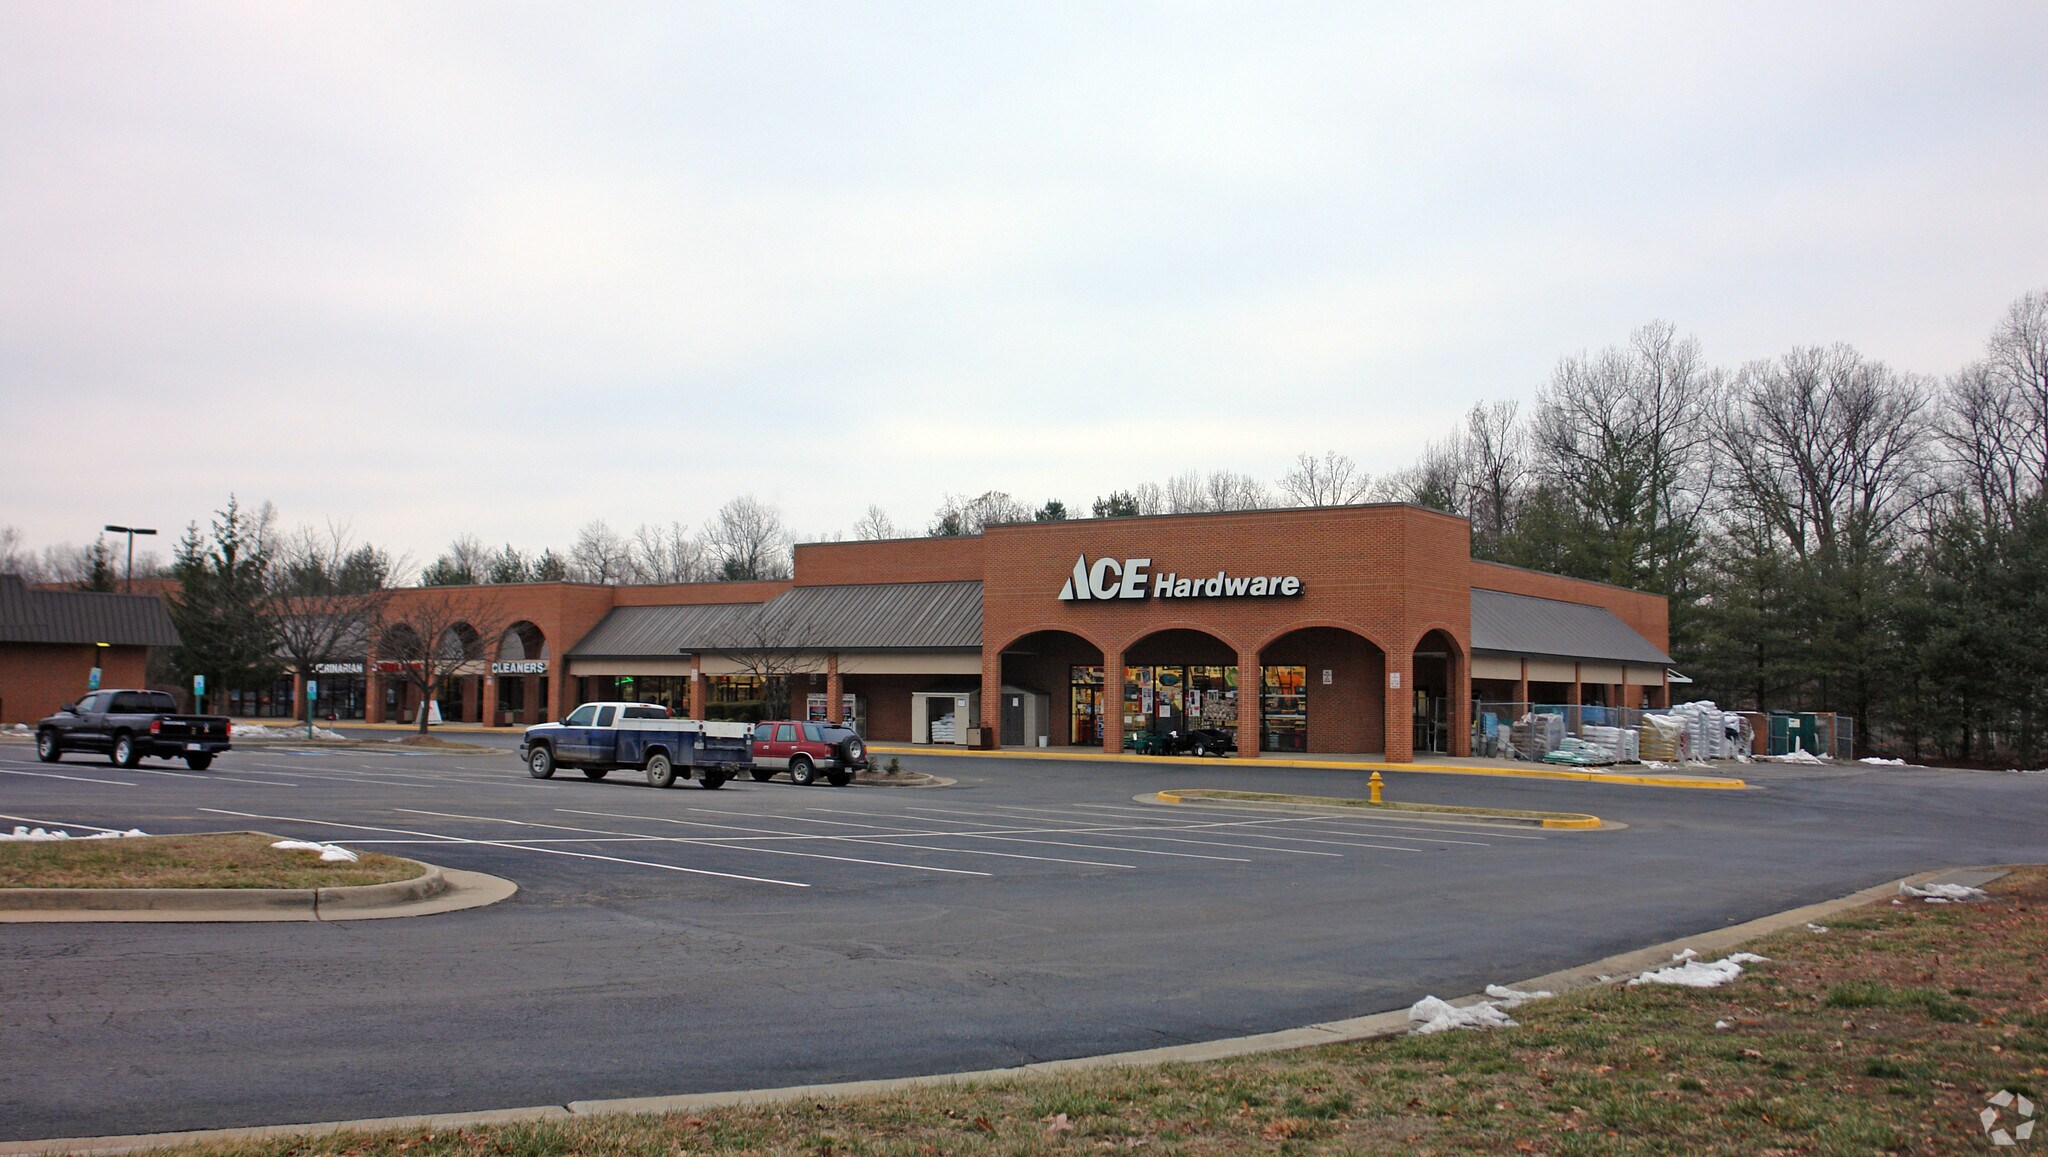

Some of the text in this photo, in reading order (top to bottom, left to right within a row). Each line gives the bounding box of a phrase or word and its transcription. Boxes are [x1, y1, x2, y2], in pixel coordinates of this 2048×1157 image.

[1057, 553, 1300, 600] ACE Hardware
[491, 662, 545, 673] CLEANERS
